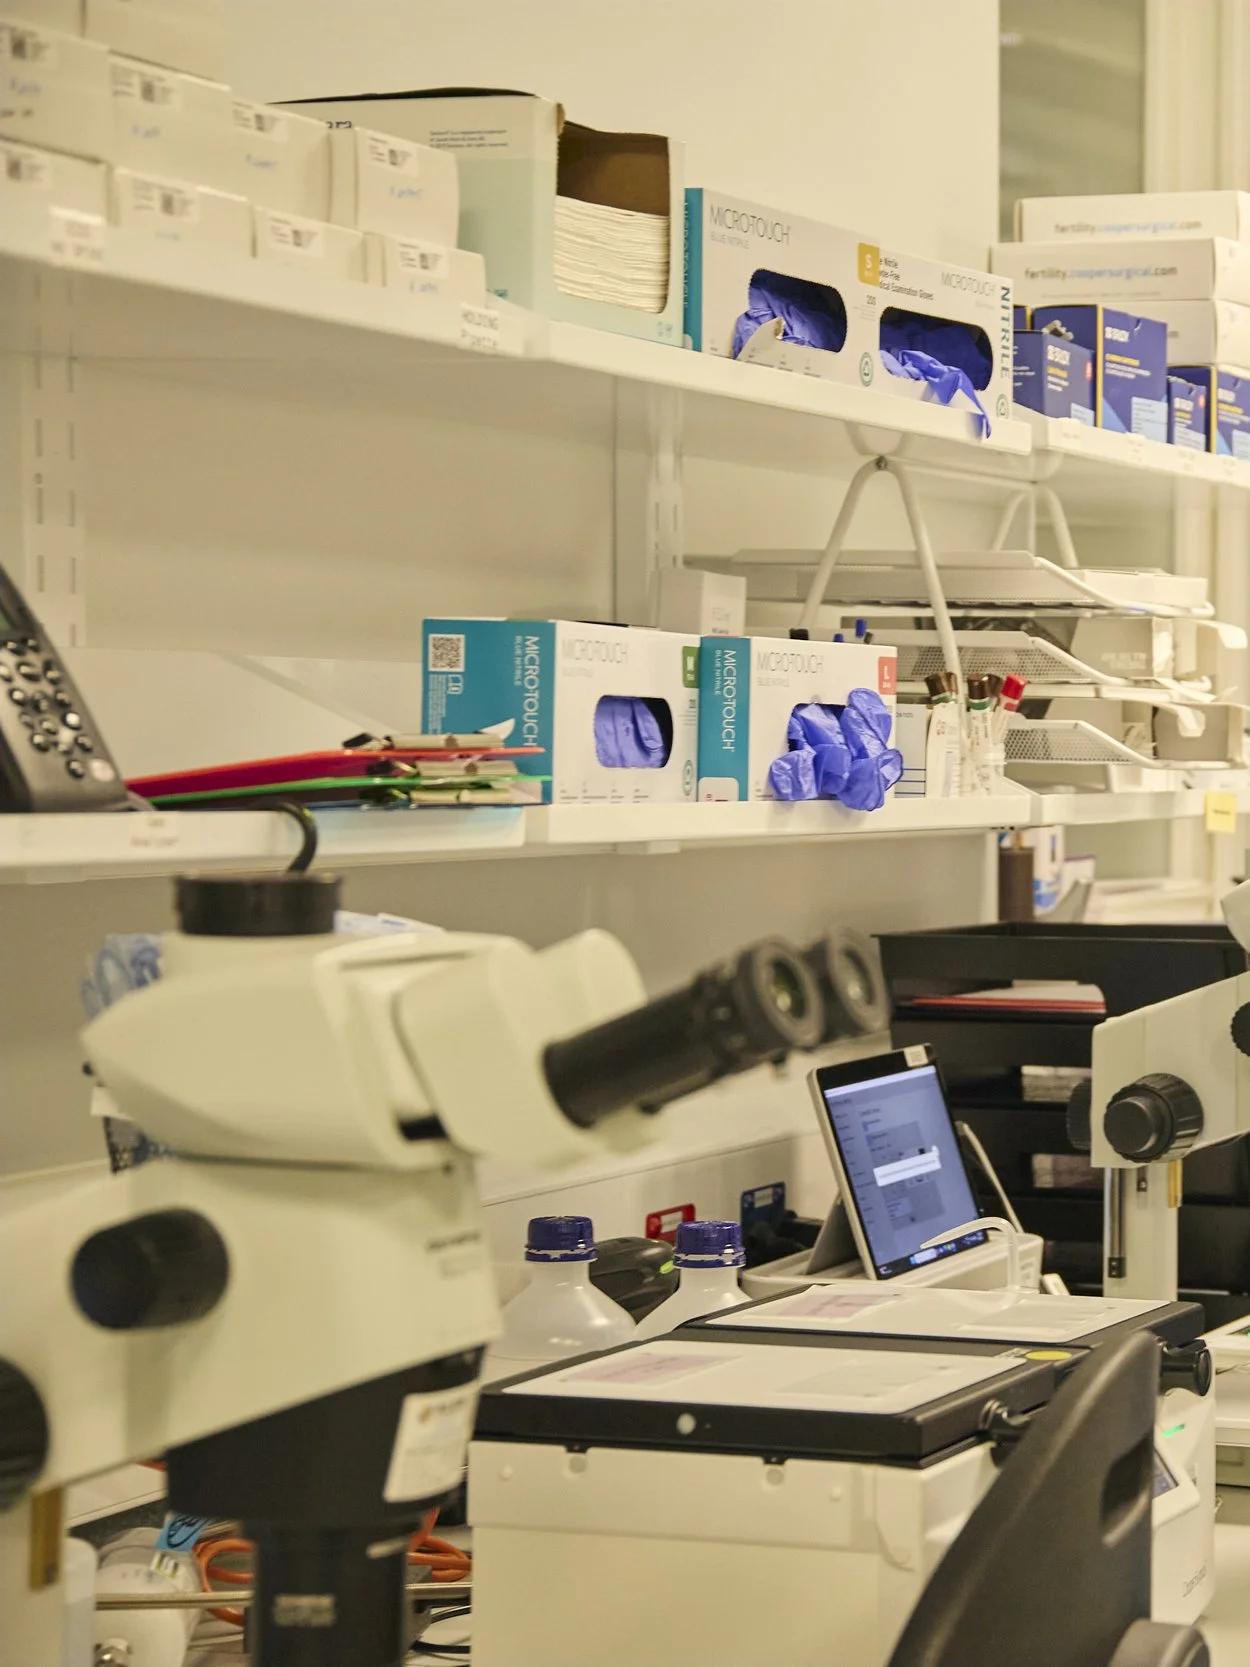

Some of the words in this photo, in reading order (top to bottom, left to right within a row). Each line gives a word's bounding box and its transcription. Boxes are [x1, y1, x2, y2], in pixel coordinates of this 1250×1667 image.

[865, 253, 872, 269] S
[1000, 286, 1010, 379] NITRILE
[883, 665, 890, 680] L
